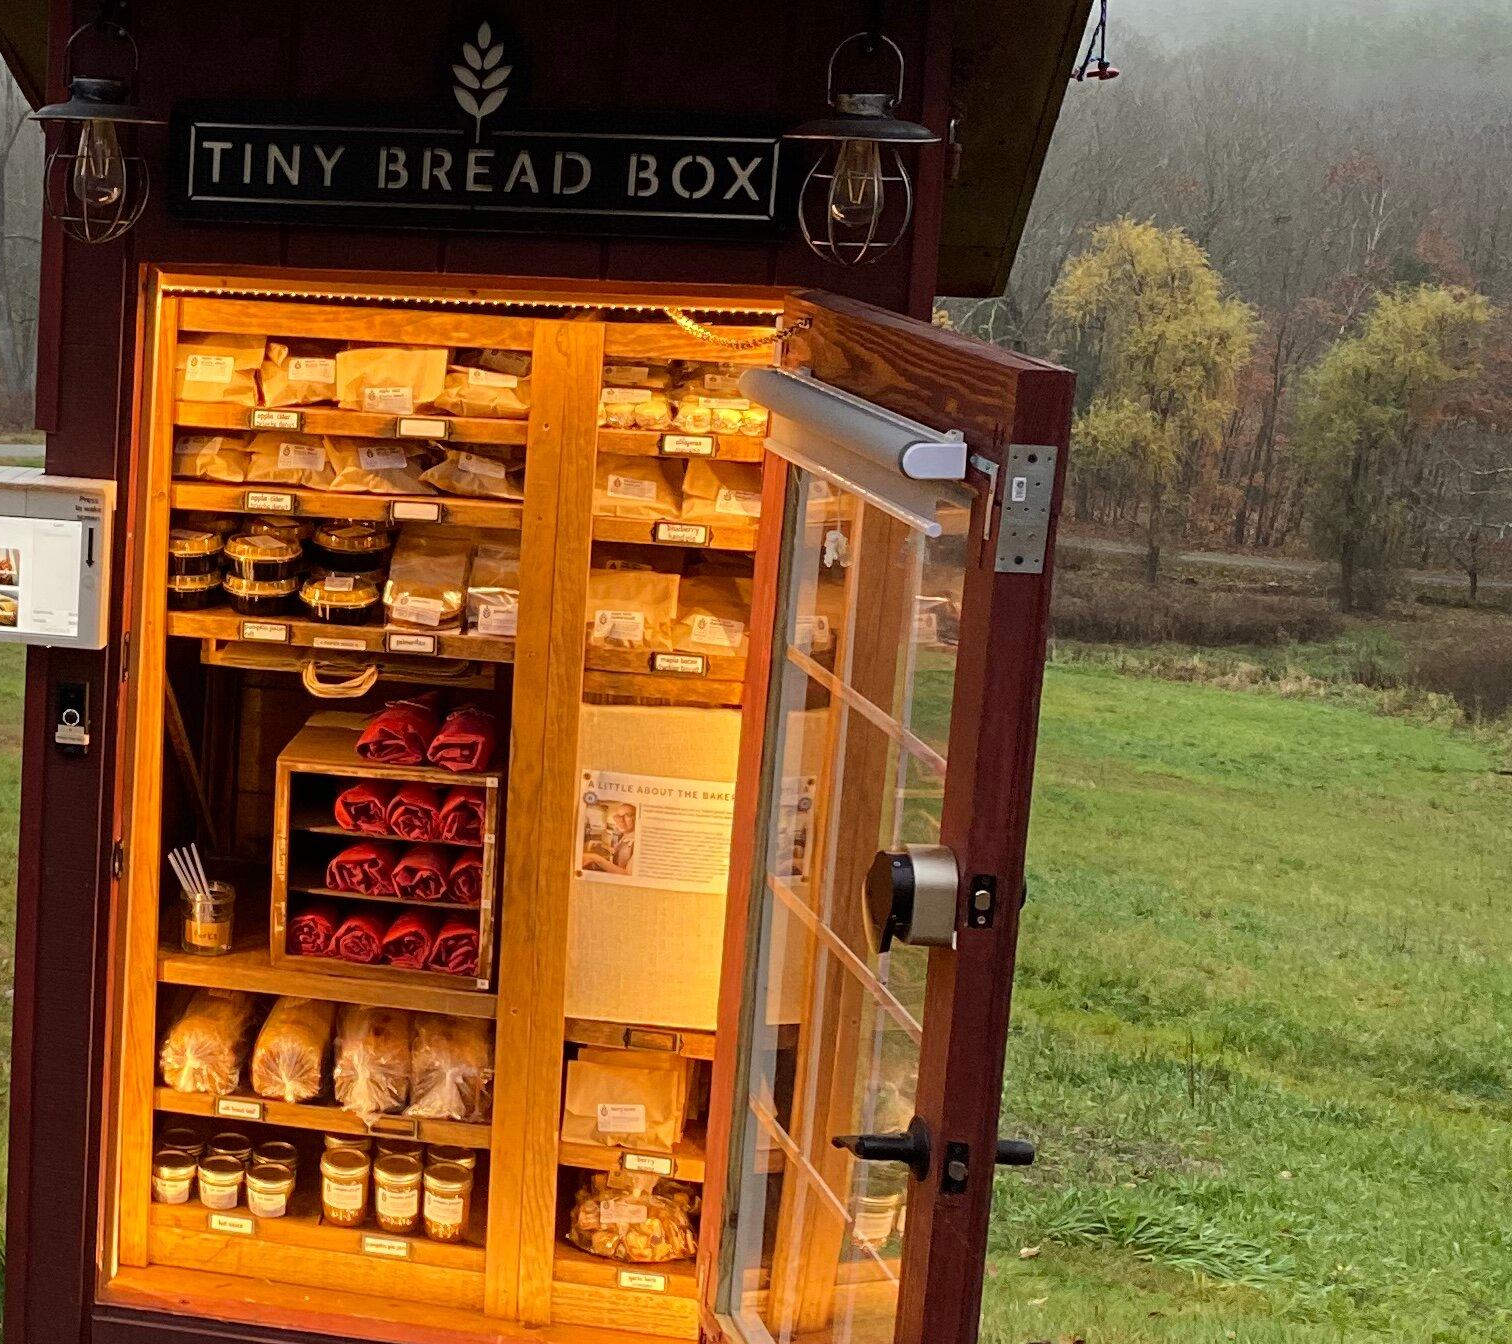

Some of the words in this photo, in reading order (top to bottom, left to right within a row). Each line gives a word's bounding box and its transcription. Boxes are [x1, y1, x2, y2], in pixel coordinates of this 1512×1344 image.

[202, 140, 346, 188] TINY
[377, 145, 592, 195] BREAD
[626, 152, 763, 201] BOX
[588, 779, 595, 788] A
[597, 782, 634, 793] LITTLE
[636, 785, 675, 797] ABOUT
[677, 790, 698, 799] THE
